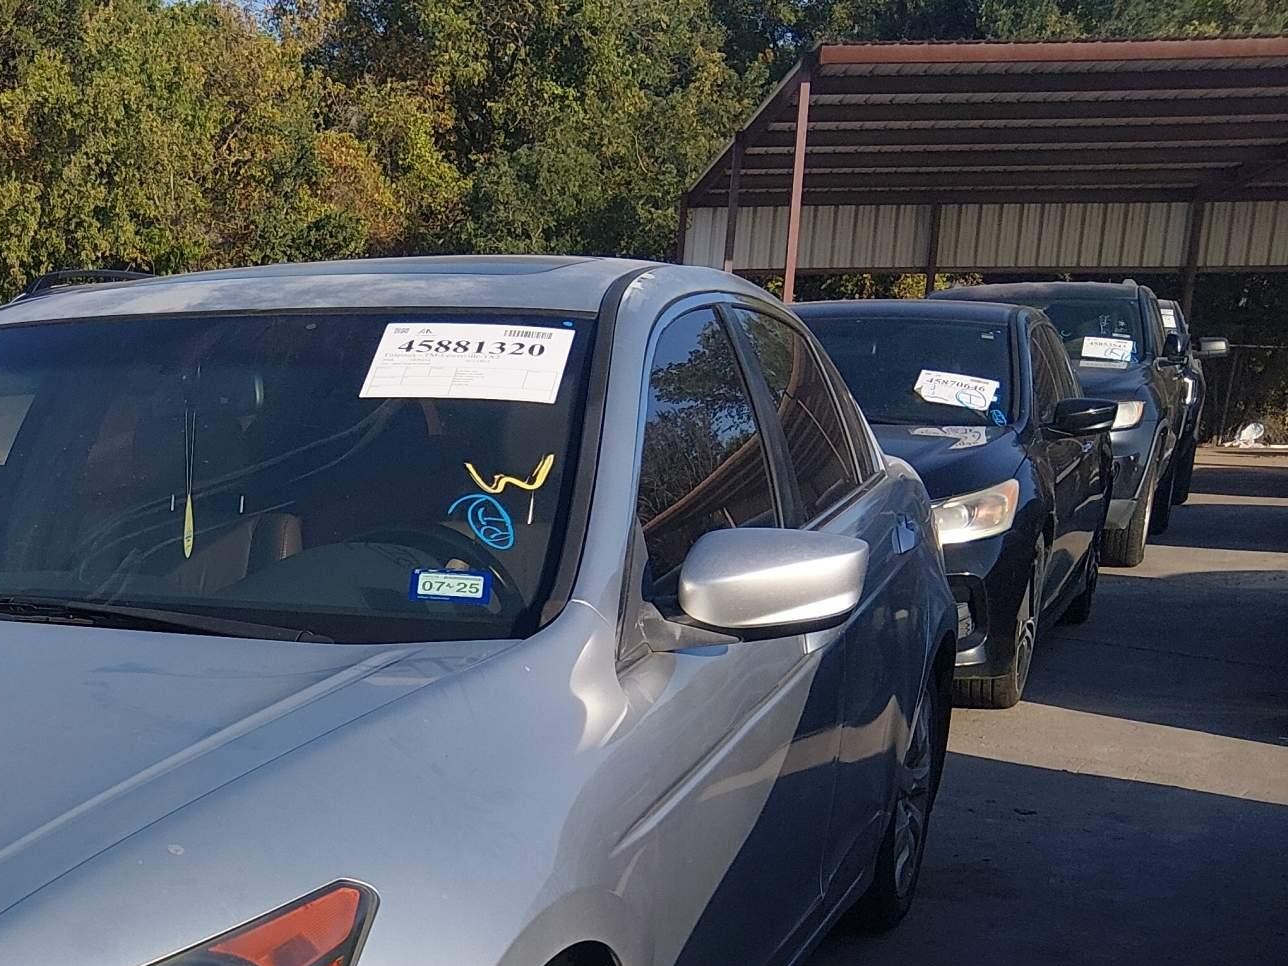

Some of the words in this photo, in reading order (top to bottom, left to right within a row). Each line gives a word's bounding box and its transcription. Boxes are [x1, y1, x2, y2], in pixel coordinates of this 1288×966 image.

[397, 339, 545, 357] 45881320
[422, 580, 445, 592] 07
[455, 582, 480, 594] 25
